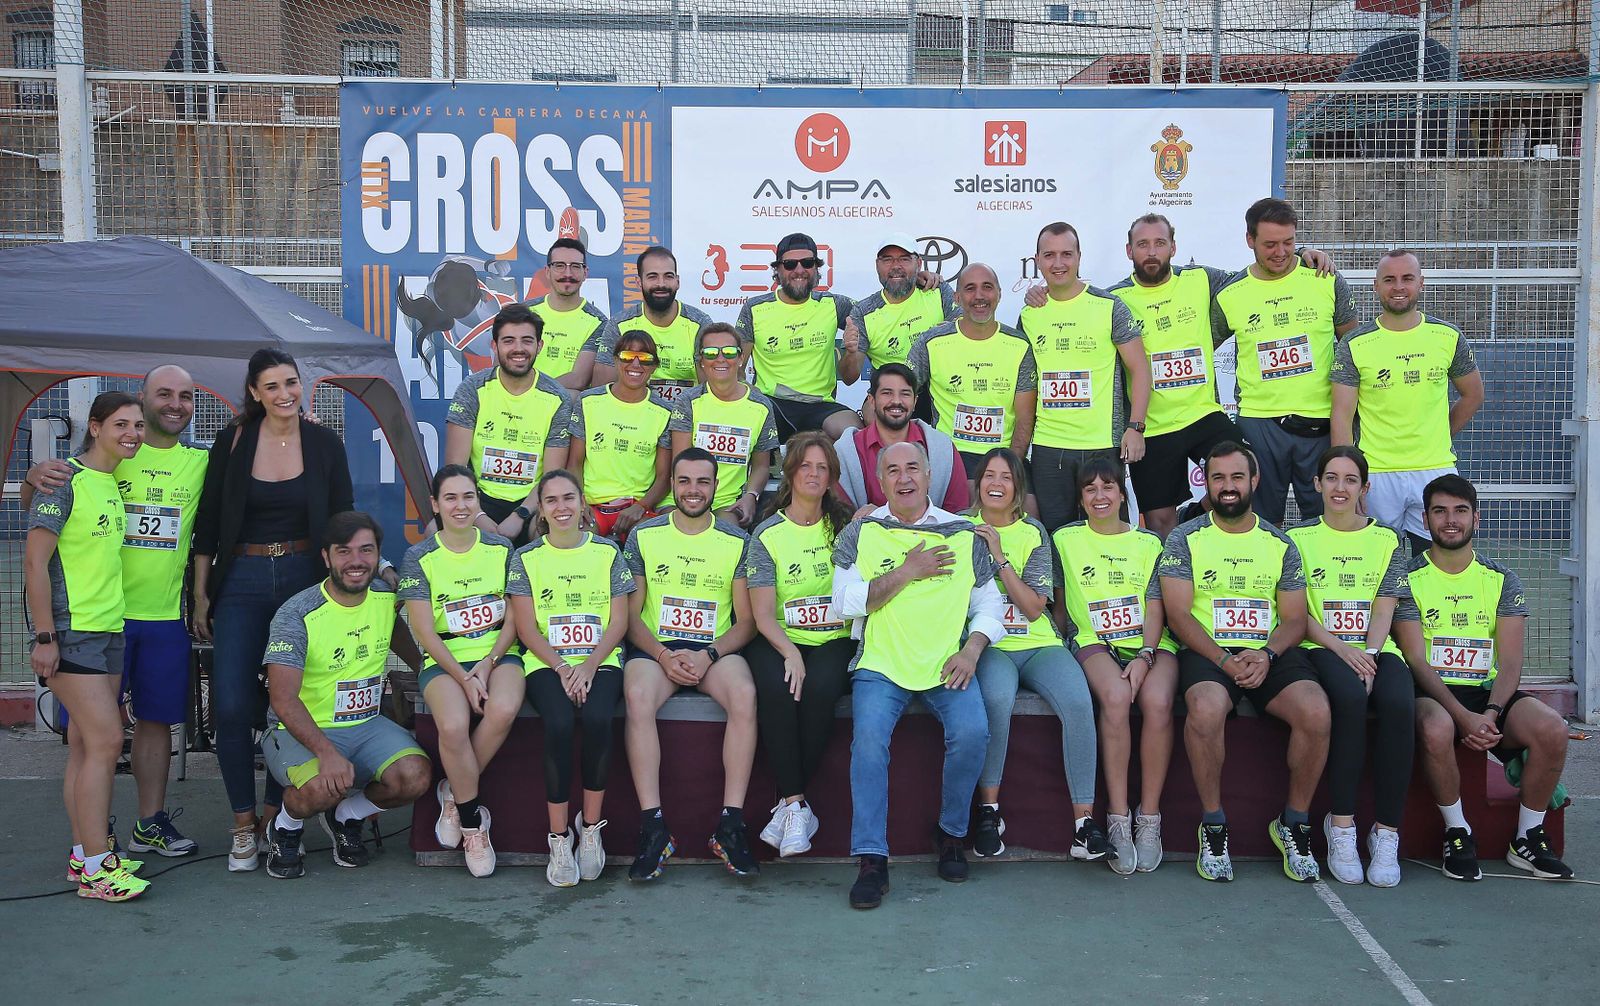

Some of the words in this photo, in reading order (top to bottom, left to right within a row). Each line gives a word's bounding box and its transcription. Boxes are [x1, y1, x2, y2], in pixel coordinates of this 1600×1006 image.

[362, 106, 432, 116] VUELVE
[446, 106, 465, 116] LA
[478, 107, 562, 118] CARRERA
[575, 109, 648, 119] DECANA
[753, 178, 891, 200] AMPA
[954, 174, 1057, 193] salesianos
[361, 131, 624, 257] CROSS
[1150, 192, 1193, 200] Ayuntamiento
[1158, 198, 1192, 208] Algeciras
[752, 206, 826, 218] SALESIANOS
[828, 206, 894, 218] ALGECIRAS
[976, 200, 1032, 211] ALGECIRAS
[701, 296, 710, 304] tu
[713, 296, 748, 308] segurid
[1268, 347, 1300, 368] 346
[1163, 358, 1193, 378] 338
[1050, 380, 1078, 398] 340
[964, 414, 993, 433] 330
[706, 434, 737, 453] 388
[492, 458, 524, 476] 334
[138, 517, 162, 536] 52
[460, 605, 493, 629] 359
[671, 608, 704, 628] 336
[797, 605, 828, 624] 387
[1100, 607, 1132, 629] 355
[1226, 609, 1258, 628] 345
[1333, 612, 1364, 630] 356
[561, 624, 593, 644] 360
[1443, 648, 1478, 668] 347
[346, 688, 372, 710] 333
